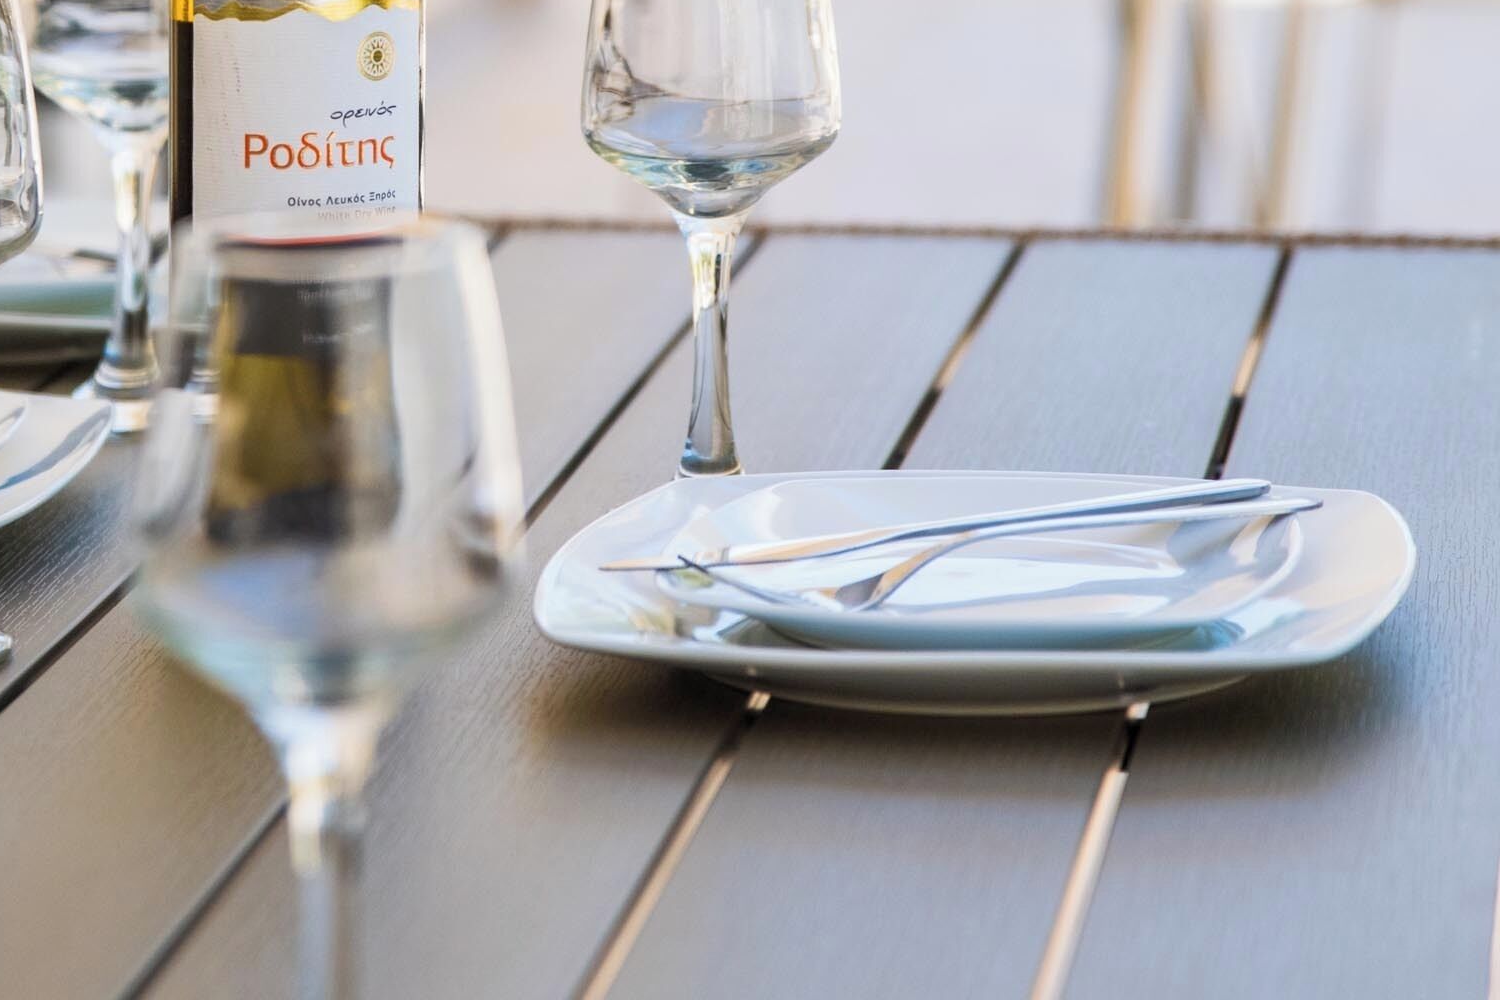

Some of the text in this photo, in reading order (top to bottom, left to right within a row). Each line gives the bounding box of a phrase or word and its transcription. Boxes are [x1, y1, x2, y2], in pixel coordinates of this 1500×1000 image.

[330, 100, 397, 128] ορεινός
[244, 130, 396, 170] Ροδίτης
[287, 189, 396, 207] Οίνος Λευκός Ξηρός
